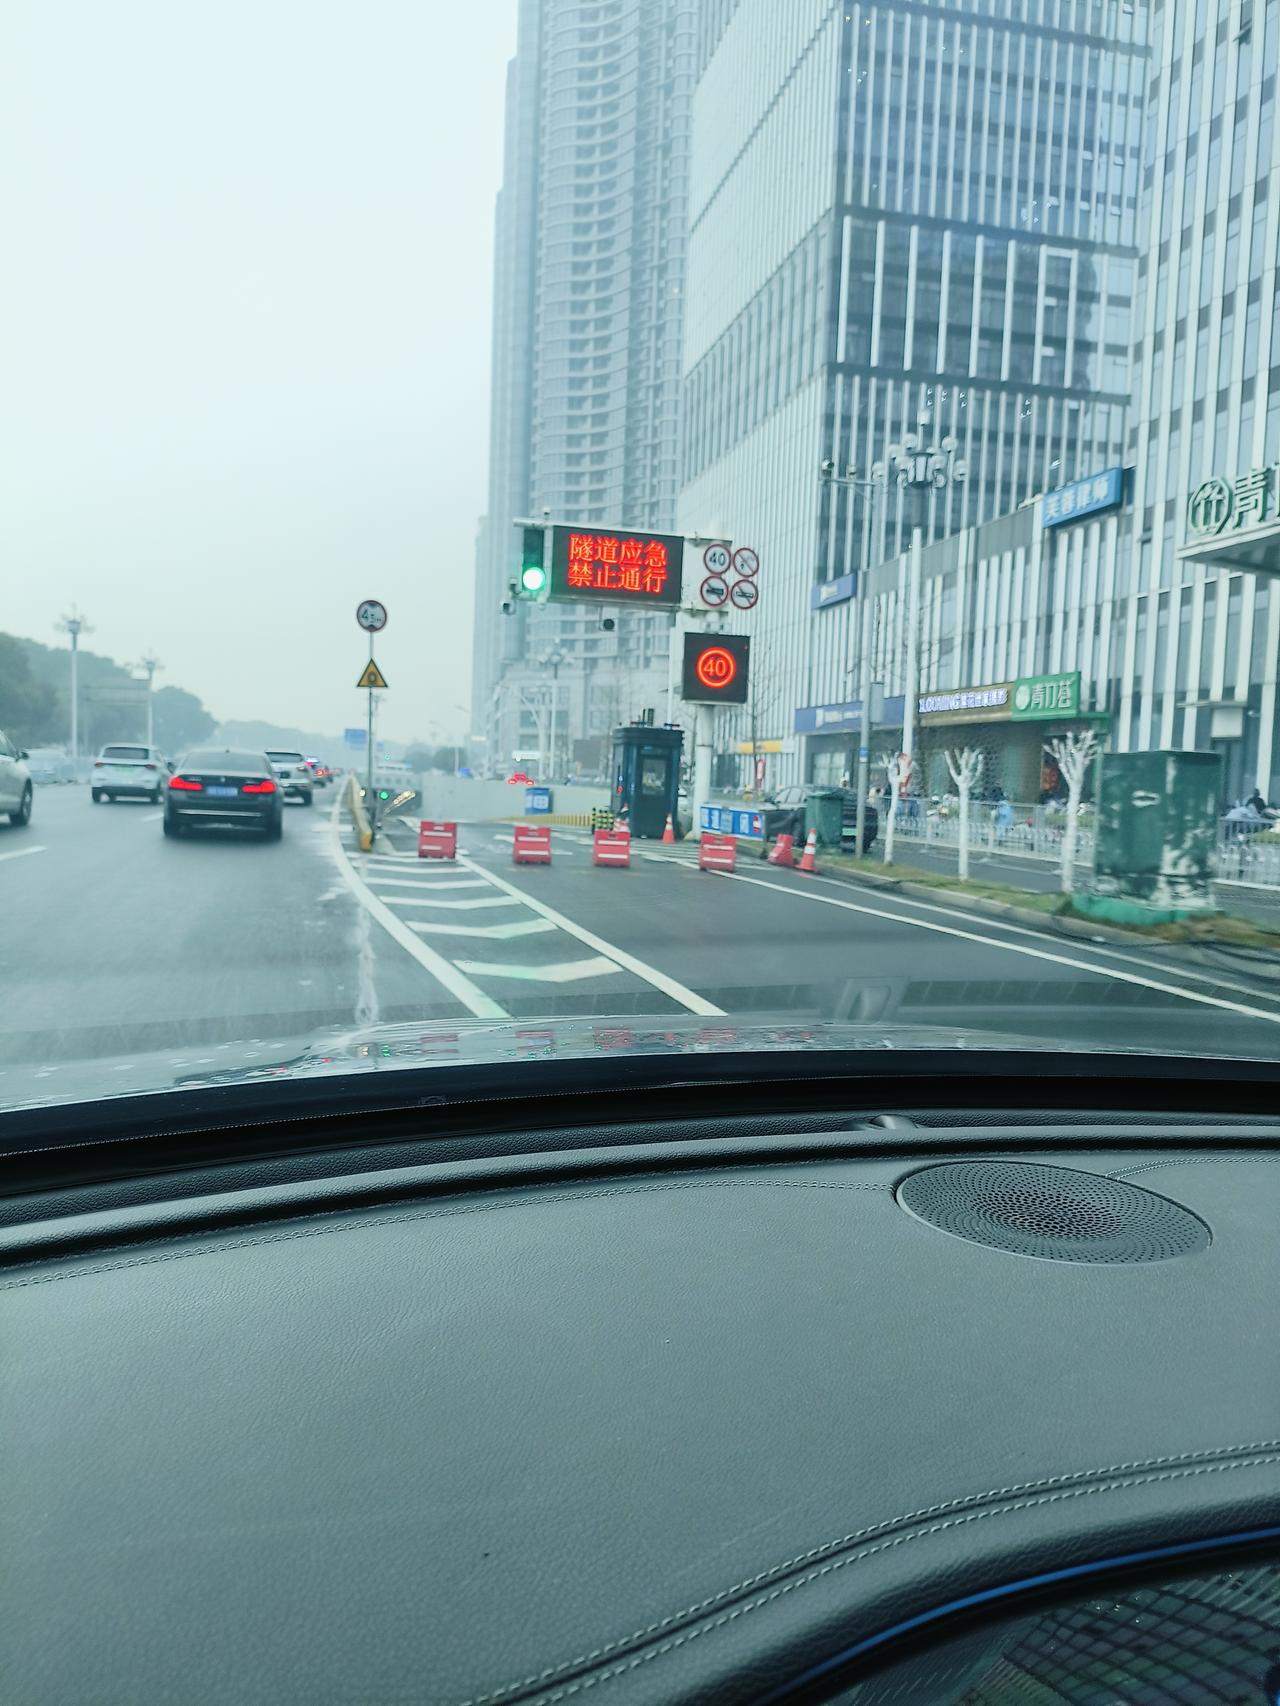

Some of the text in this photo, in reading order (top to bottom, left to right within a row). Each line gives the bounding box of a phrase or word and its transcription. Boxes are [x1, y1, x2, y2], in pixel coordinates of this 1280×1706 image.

[1233, 461, 1280, 529] 青
[569, 534, 667, 568] 隧道应急
[709, 552, 726, 566] 40
[568, 561, 667, 594] 禁止通行
[703, 657, 726, 677] 40
